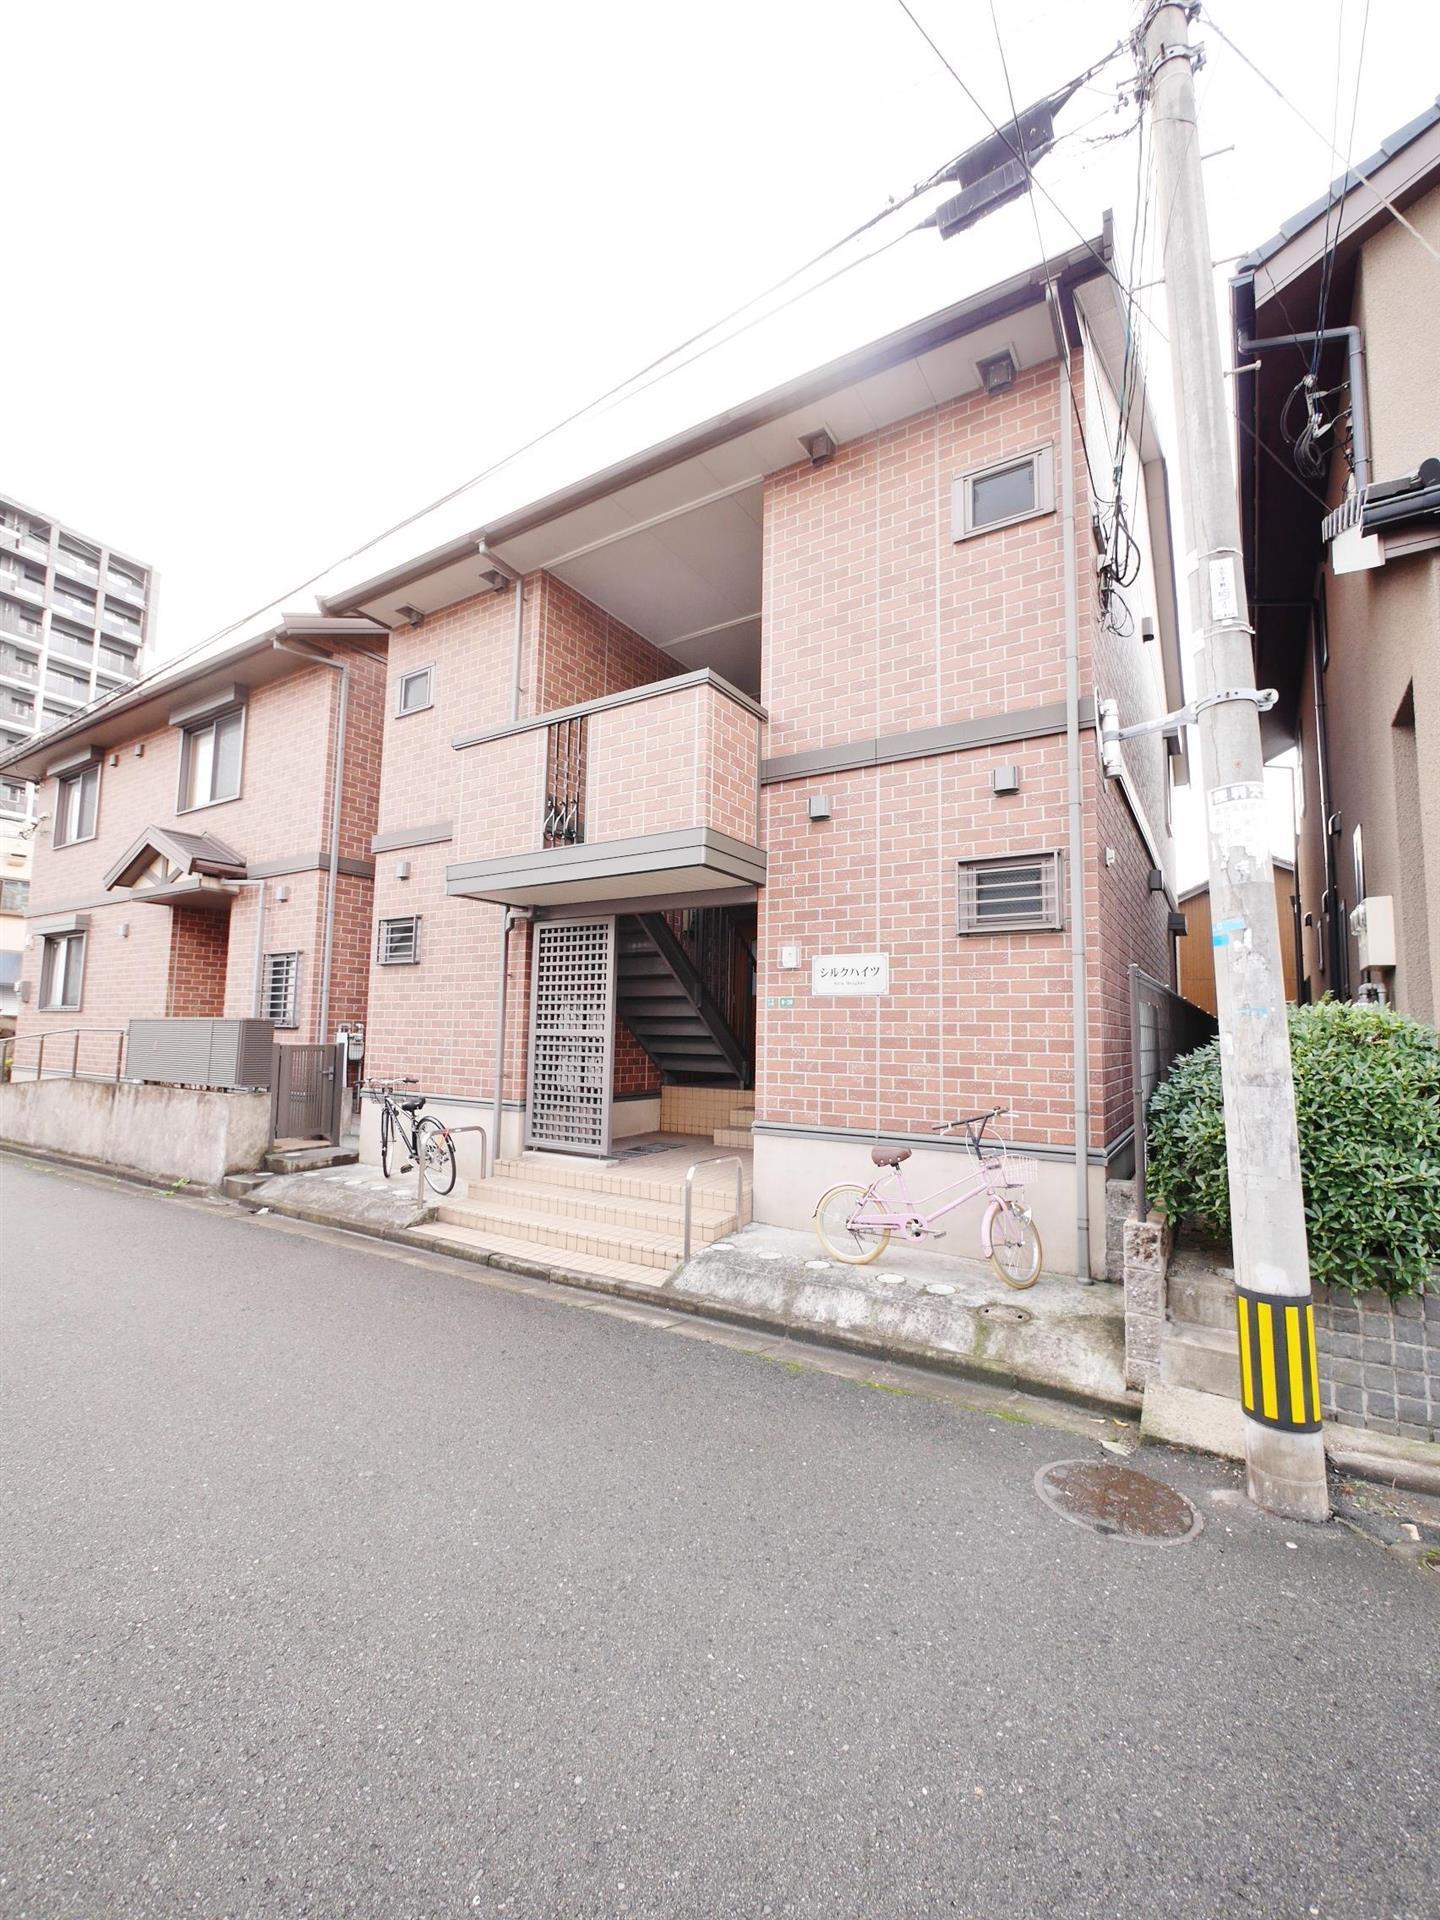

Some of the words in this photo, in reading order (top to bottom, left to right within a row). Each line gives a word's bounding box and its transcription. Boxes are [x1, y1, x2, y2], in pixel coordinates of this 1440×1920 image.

[820, 966, 880, 978] シルクハイツ
